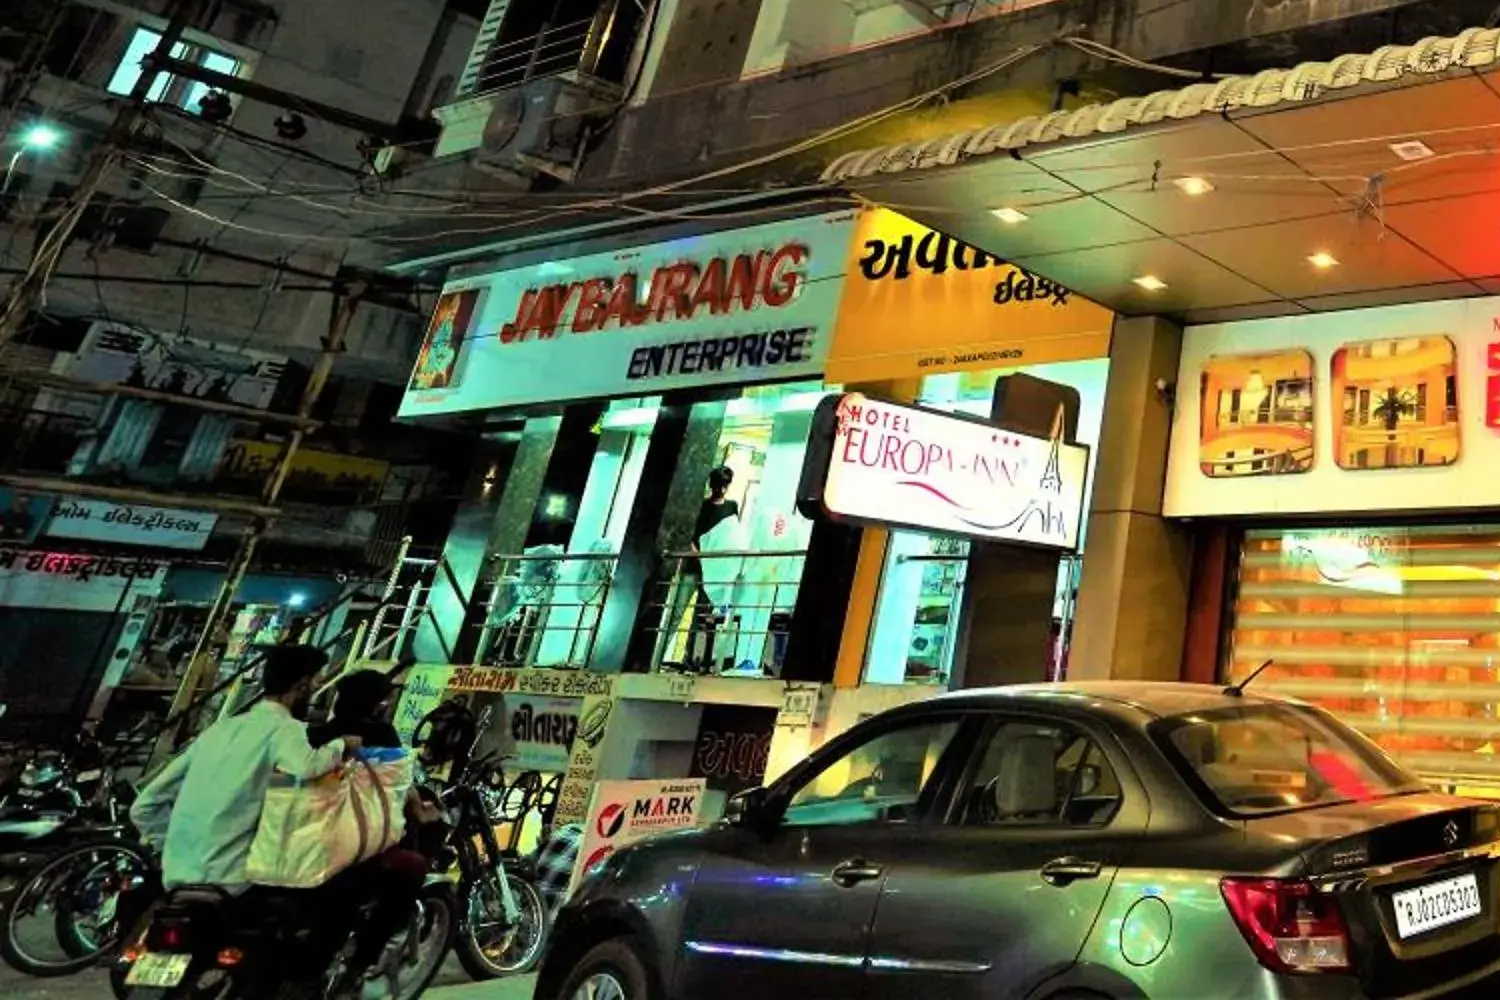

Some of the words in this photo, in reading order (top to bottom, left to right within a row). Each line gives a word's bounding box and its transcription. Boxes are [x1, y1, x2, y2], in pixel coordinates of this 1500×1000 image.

[500, 281, 574, 344] JAY
[571, 243, 807, 333] BAJRANG
[627, 328, 814, 380] ENTERPRISE
[851, 405, 910, 433] HOTEL
[633, 796, 695, 818] MARK
